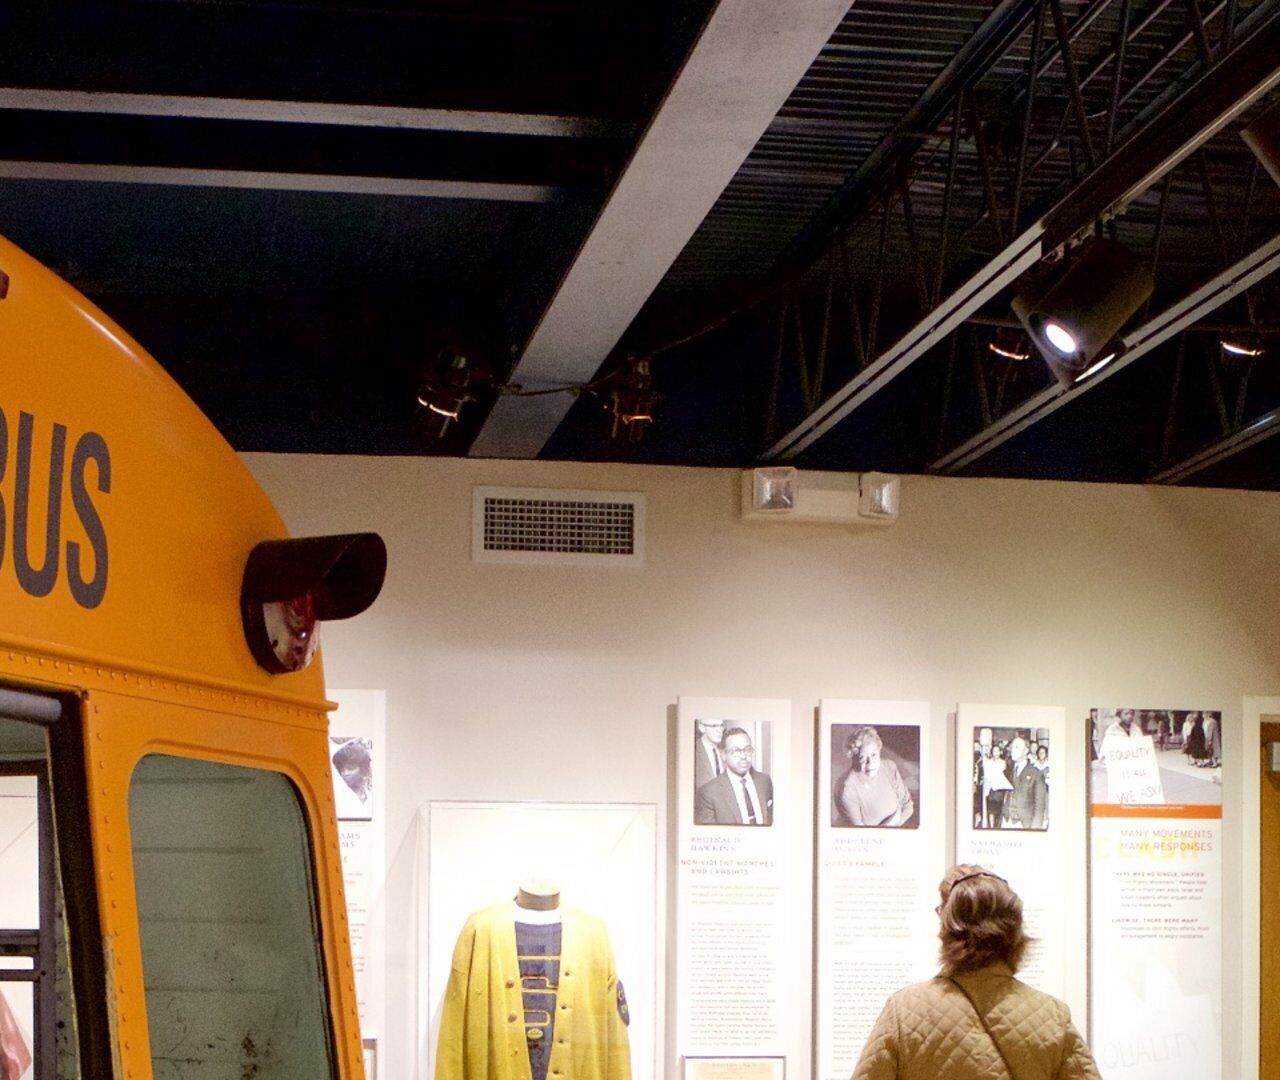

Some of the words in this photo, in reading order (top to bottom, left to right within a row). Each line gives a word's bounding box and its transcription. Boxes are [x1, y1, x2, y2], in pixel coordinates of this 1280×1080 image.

[1109, 747, 1150, 760] EQUALITY
[1116, 790, 1136, 804] WE
[1120, 829, 1149, 837] MANY
[1153, 829, 1213, 839] MOVEMENTS
[1120, 842, 1149, 851] MANY
[1153, 842, 1213, 851] RESPONSES
